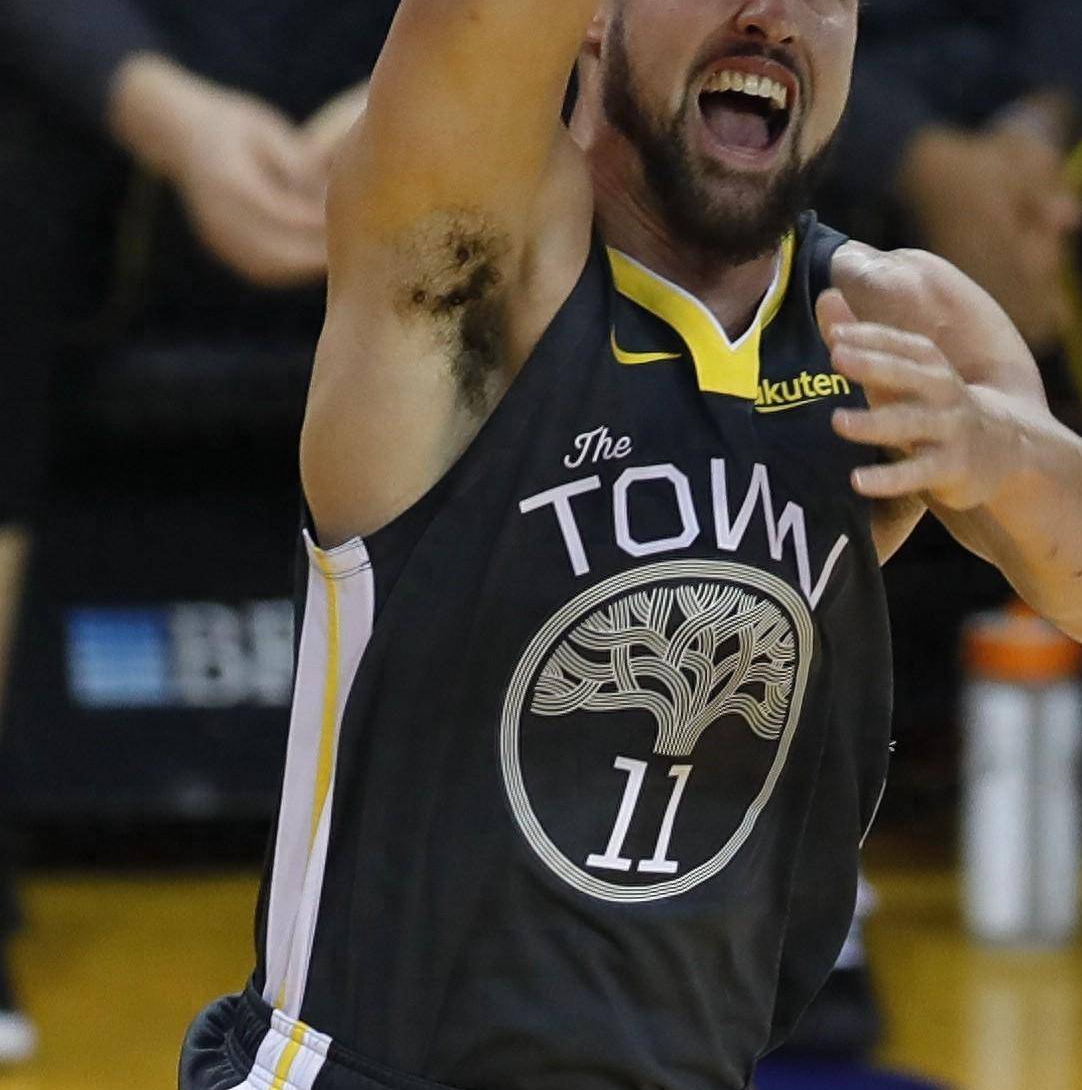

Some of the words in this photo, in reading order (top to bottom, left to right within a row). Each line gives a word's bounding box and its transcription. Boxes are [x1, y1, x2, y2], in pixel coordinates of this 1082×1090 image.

[563, 425, 633, 469] The
[518, 457, 849, 612] TOWN
[585, 755, 693, 874] 11
